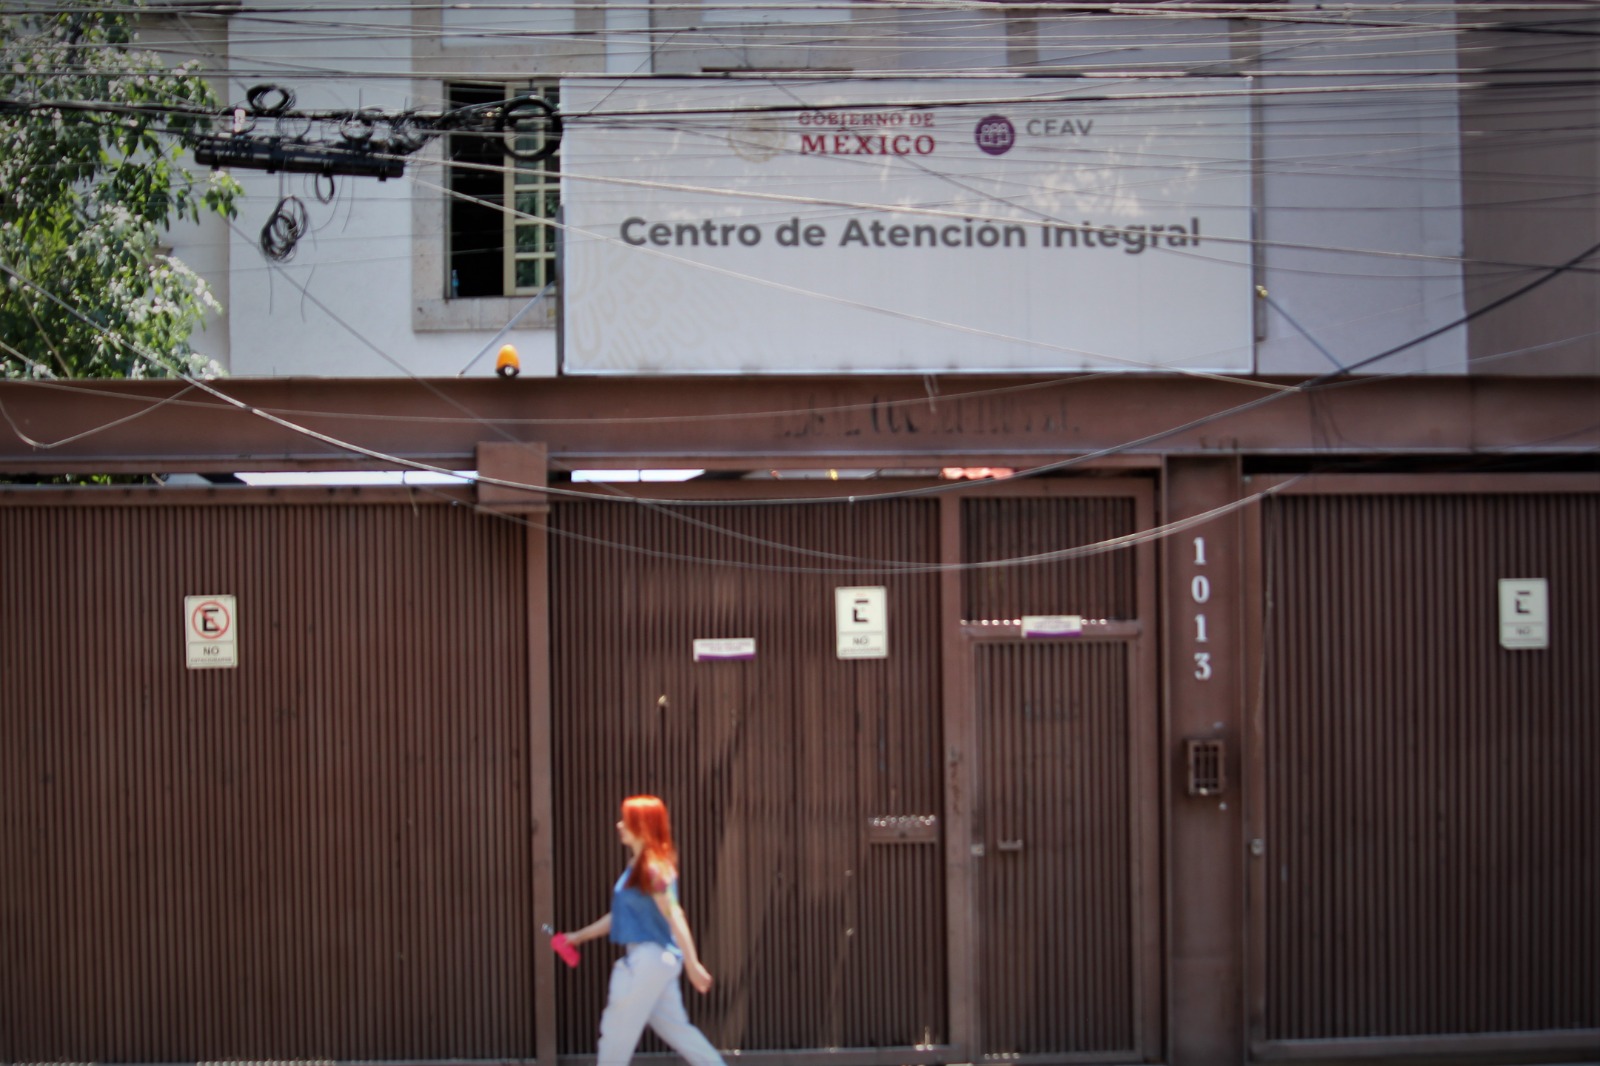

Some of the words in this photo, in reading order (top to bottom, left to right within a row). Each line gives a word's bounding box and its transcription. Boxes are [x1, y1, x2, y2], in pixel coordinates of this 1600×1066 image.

[799, 111, 903, 127] GOBIERNO
[909, 112, 936, 128] DE
[1026, 118, 1094, 137] CEAV
[801, 127, 936, 156] MÉXICO
[619, 216, 762, 247] Centro
[774, 217, 827, 247] de
[838, 217, 1027, 248] Atención
[1041, 217, 1200, 255] Integral
[203, 646, 220, 656] NO
